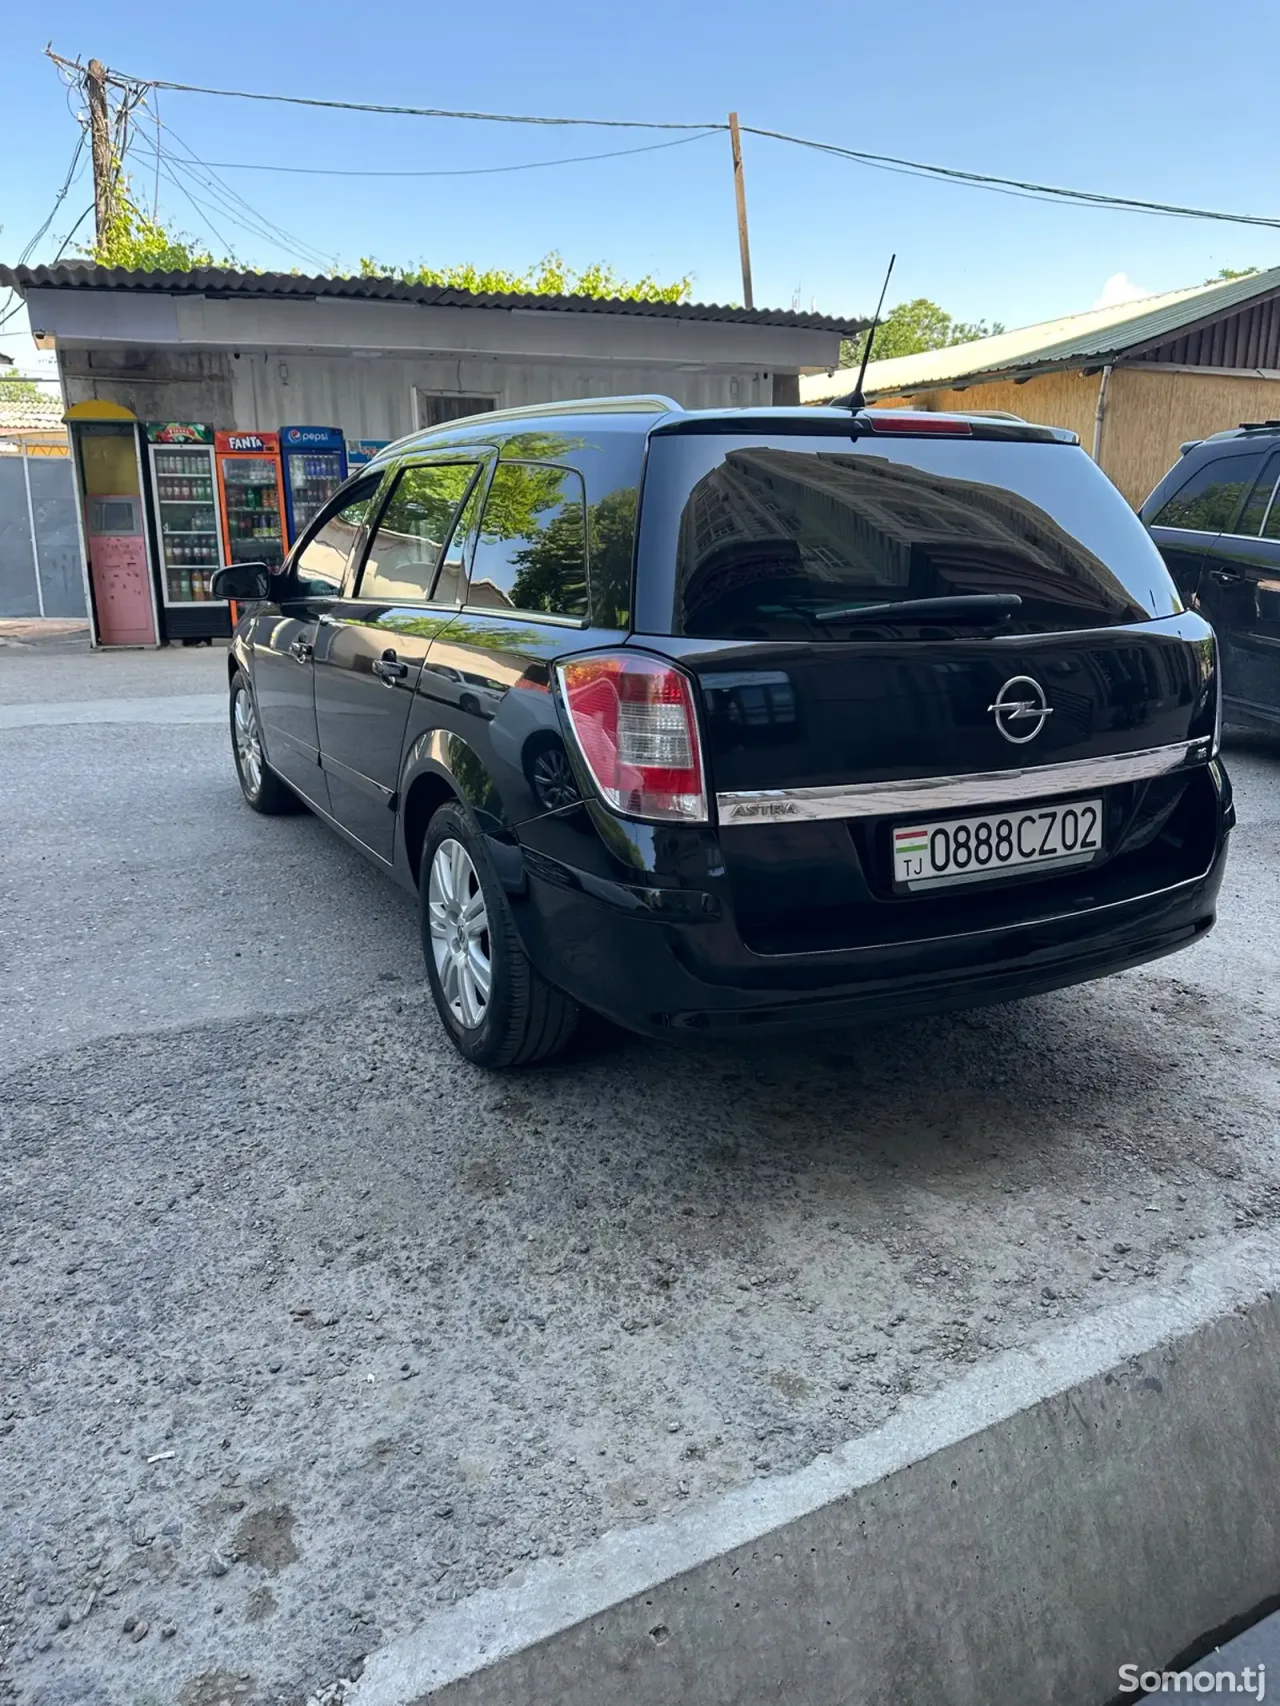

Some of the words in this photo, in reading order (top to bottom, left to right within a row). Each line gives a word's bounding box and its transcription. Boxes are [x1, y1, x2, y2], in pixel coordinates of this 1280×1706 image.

[228, 435, 263, 450] FANTA
[302, 432, 328, 442] pepsi
[730, 802, 799, 817] ASTRA
[930, 806, 1098, 872] 0888CZ02
[903, 858, 924, 877] TJ
